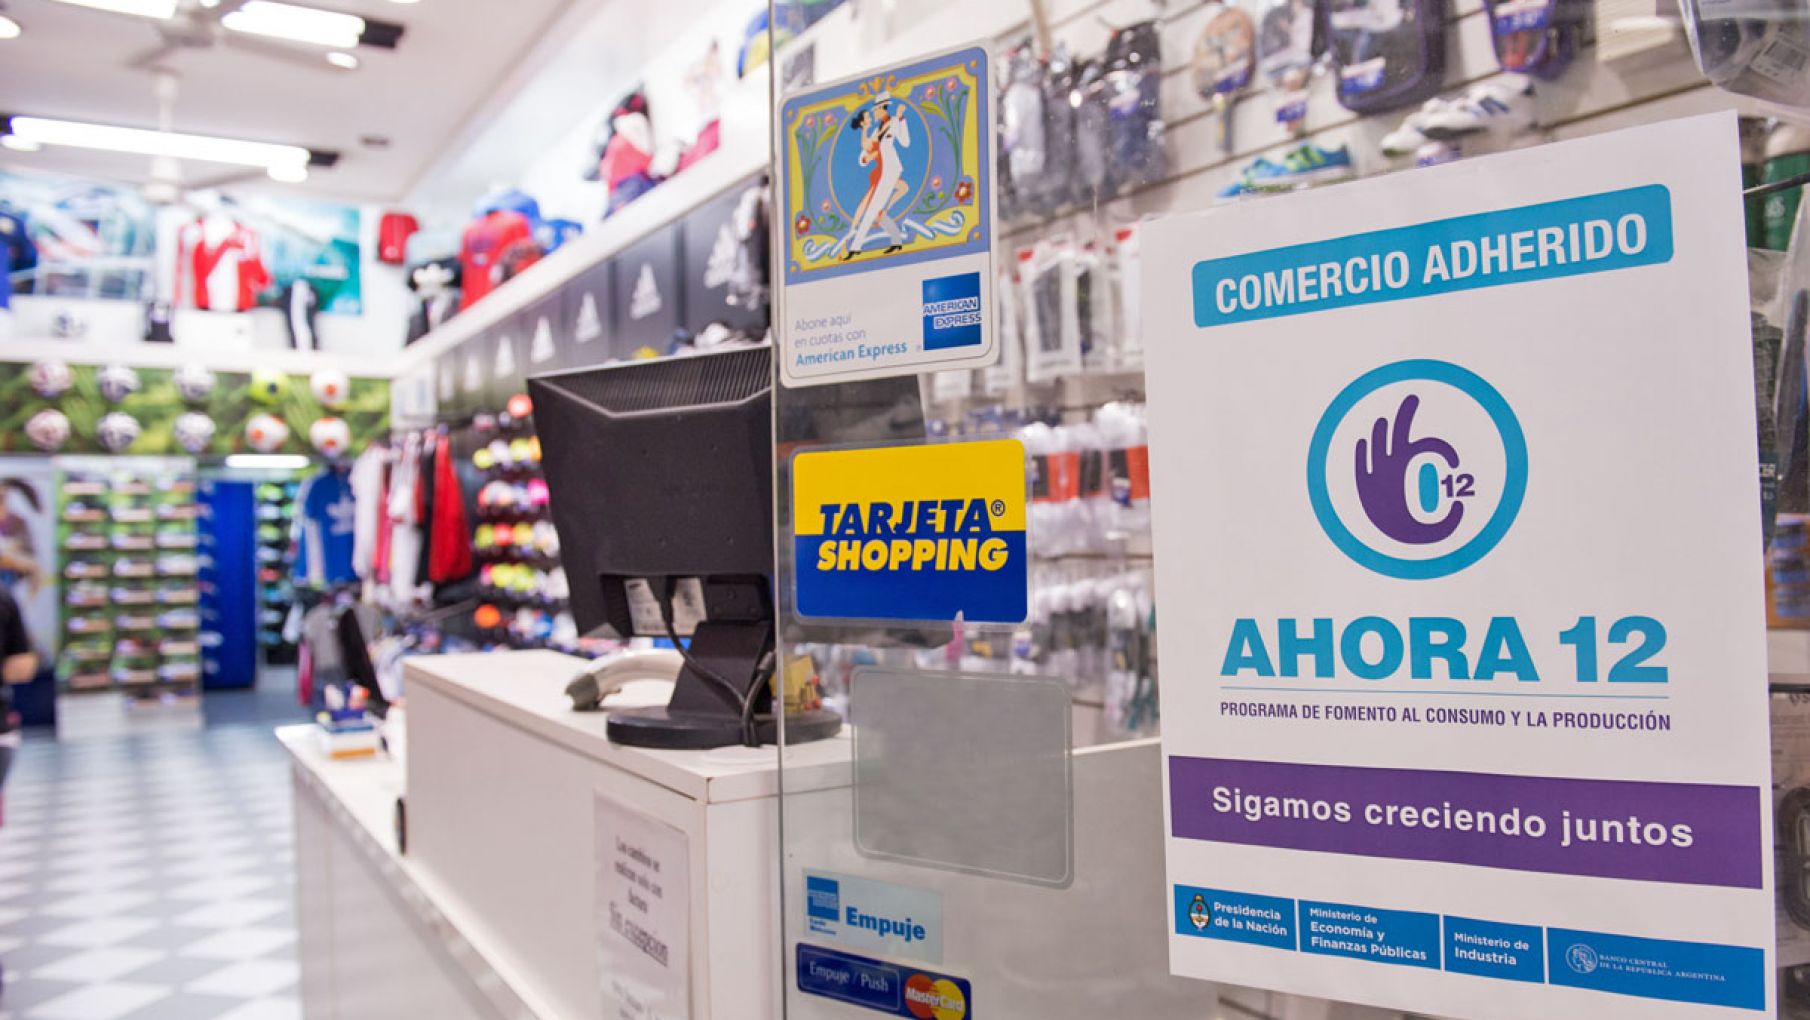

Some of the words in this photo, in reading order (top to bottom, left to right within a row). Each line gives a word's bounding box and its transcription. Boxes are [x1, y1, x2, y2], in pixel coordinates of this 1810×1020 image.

[1215, 250, 1410, 314] COMERCIO
[1423, 213, 1648, 284] ADHERIDO
[922, 298, 978, 315] AMERICAN
[794, 318, 828, 331] Abone
[935, 313, 982, 328] EXPRESS
[794, 338, 807, 348] en
[809, 332, 844, 346] cuotas
[846, 329, 866, 341] con
[796, 348, 855, 366] American
[858, 342, 908, 360] Express
[1441, 473, 1475, 498] 12
[816, 538, 1009, 572] SHOPPING
[1220, 615, 1541, 682] AHORA
[1559, 615, 1669, 683] 12
[1220, 702, 1298, 719] PROGRAMA
[1302, 704, 1321, 720] DE
[1325, 705, 1397, 722] FOMENTO
[1401, 707, 1421, 723] AL
[1426, 708, 1506, 726] CONSUMO
[1510, 711, 1522, 727] Y
[1527, 711, 1548, 728] LA
[1553, 709, 1671, 731] PRODUCCIÓN
[1212, 786, 1351, 822] Sigamos
[1364, 801, 1547, 838] creciendo
[1561, 810, 1694, 848] juntos
[1214, 902, 1281, 921] Presidencia
[1310, 908, 1361, 923] Ministerio
[1364, 913, 1378, 925] de
[846, 906, 926, 942] Empuje
[1214, 916, 1230, 928] de
[1232, 919, 1243, 930] la
[1246, 920, 1287, 936] Nación
[1310, 922, 1373, 938] Economía
[1377, 930, 1385, 942] y
[1311, 936, 1367, 953] Finanzas
[1371, 943, 1428, 961] Públicas
[1454, 932, 1511, 950] Ministerio
[1514, 939, 1529, 951] de
[1454, 947, 1517, 966] Industria
[1599, 954, 1627, 964] BANCO
[1628, 959, 1667, 968] CENTRAL
[809, 961, 850, 985] Empuje
[860, 973, 889, 993] Push
[1613, 963, 1623, 971] LA
[1675, 971, 1727, 982] ARGENTINA
[905, 986, 963, 1012] MasterCard
